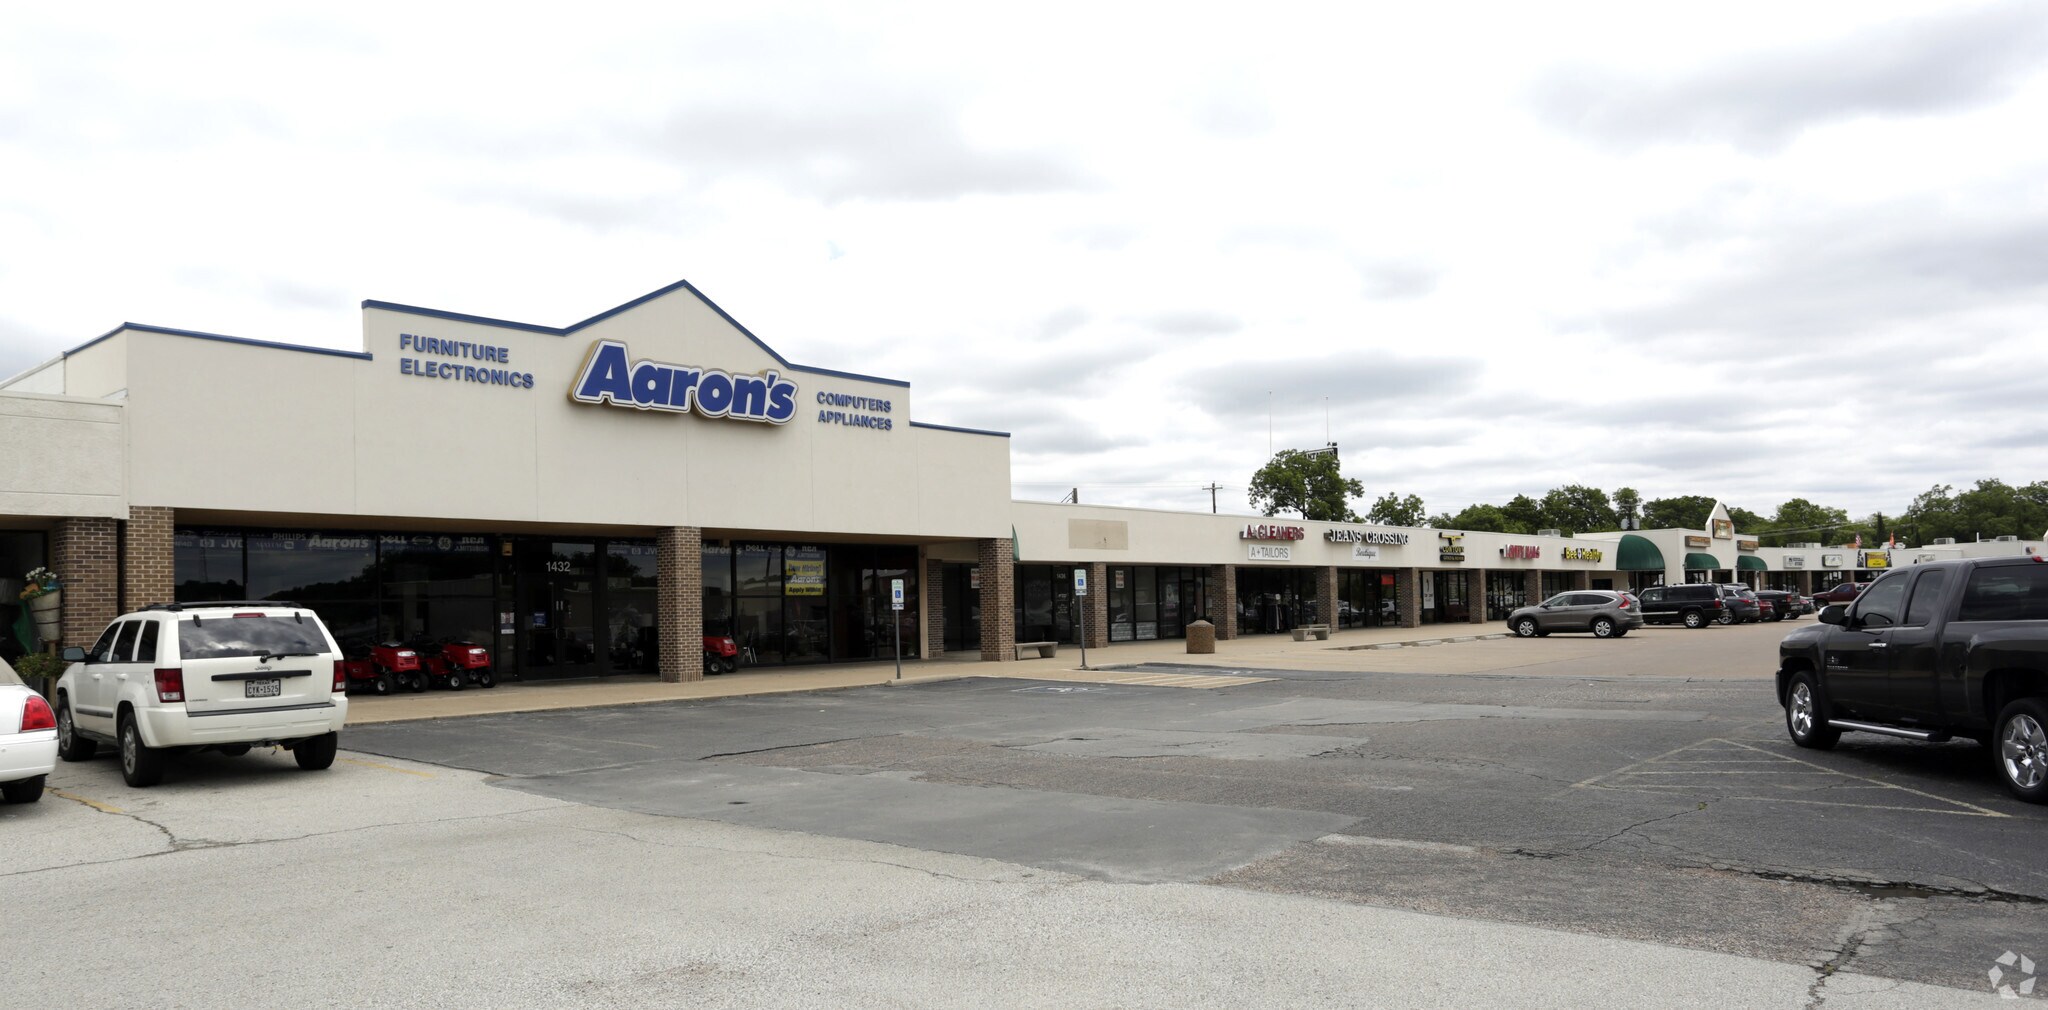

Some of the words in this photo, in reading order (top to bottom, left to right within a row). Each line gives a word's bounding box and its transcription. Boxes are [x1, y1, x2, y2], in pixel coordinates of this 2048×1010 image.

[400, 333, 509, 363] FURNITURE
[400, 357, 534, 389] ELECTRONICS
[577, 343, 797, 421] Aaron's
[816, 391, 892, 413] COMPUTERS
[818, 410, 893, 431] APPLIANCES
[272, 532, 307, 541] PHILIPS
[308, 534, 370, 549] Aaron's
[1329, 529, 1362, 543] JEANS
[1365, 531, 1409, 545] CROSSING
[1565, 547, 1578, 560] Bee
[546, 561, 571, 572] 1432
